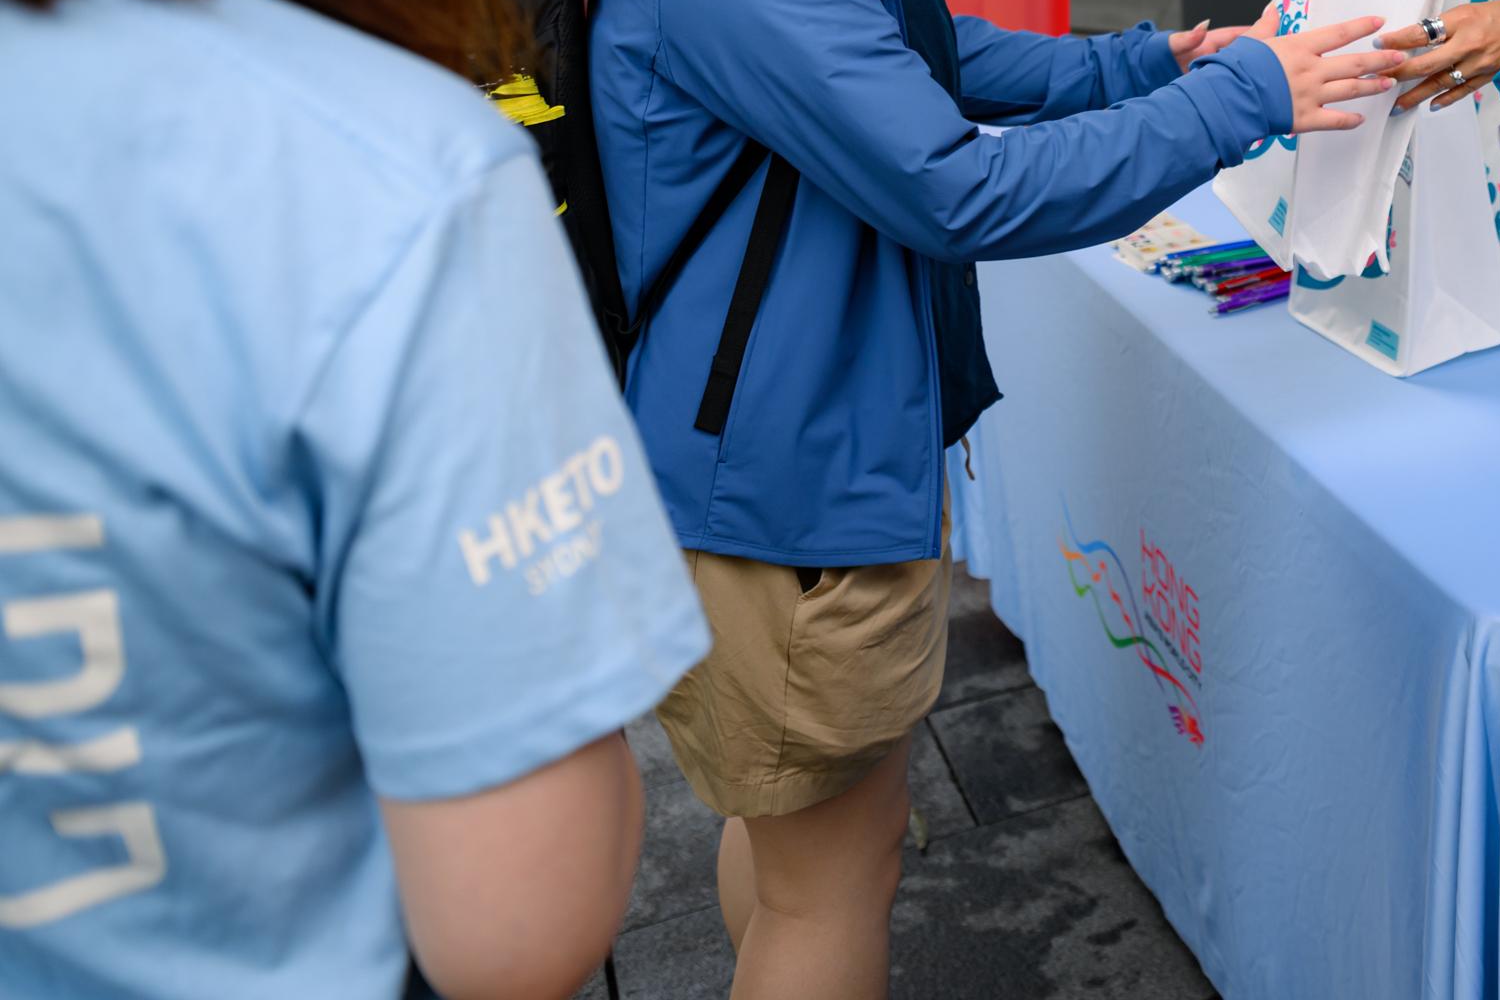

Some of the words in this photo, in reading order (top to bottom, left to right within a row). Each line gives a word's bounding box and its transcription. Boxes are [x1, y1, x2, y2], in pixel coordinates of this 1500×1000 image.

[457, 434, 624, 586] HKETO
[1139, 528, 1200, 631] HONG
[1142, 568, 1202, 674] KONG
